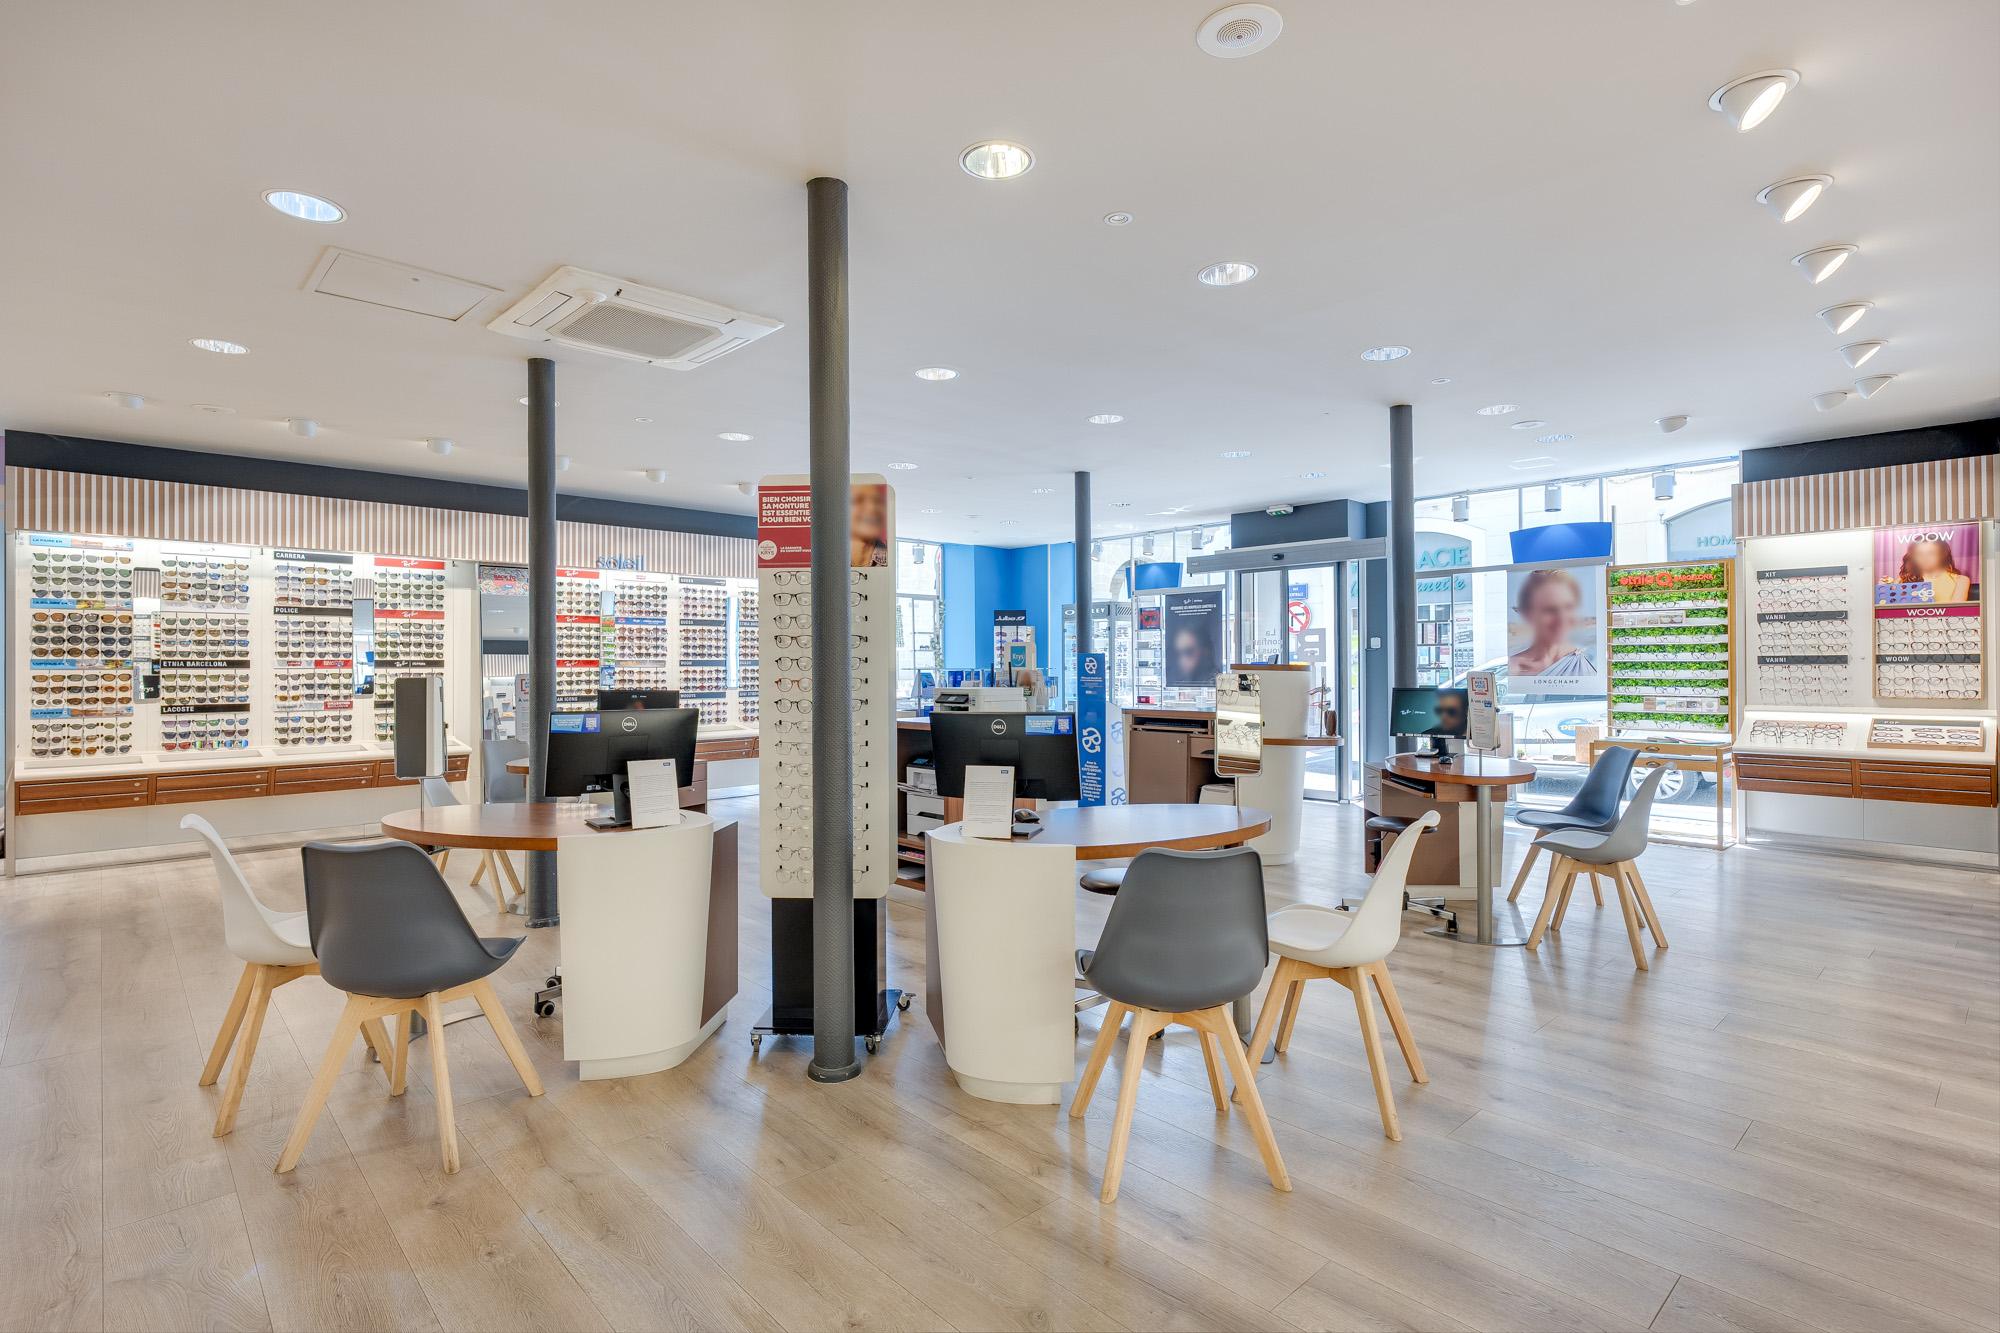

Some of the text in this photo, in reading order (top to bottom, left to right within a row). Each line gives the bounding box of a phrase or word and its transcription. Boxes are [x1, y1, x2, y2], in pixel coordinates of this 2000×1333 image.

[1897, 530, 1955, 545] WOOW
[275, 552, 306, 560] CARRERA
[596, 553, 645, 570] soleil
[1906, 607, 1946, 616] WOOW
